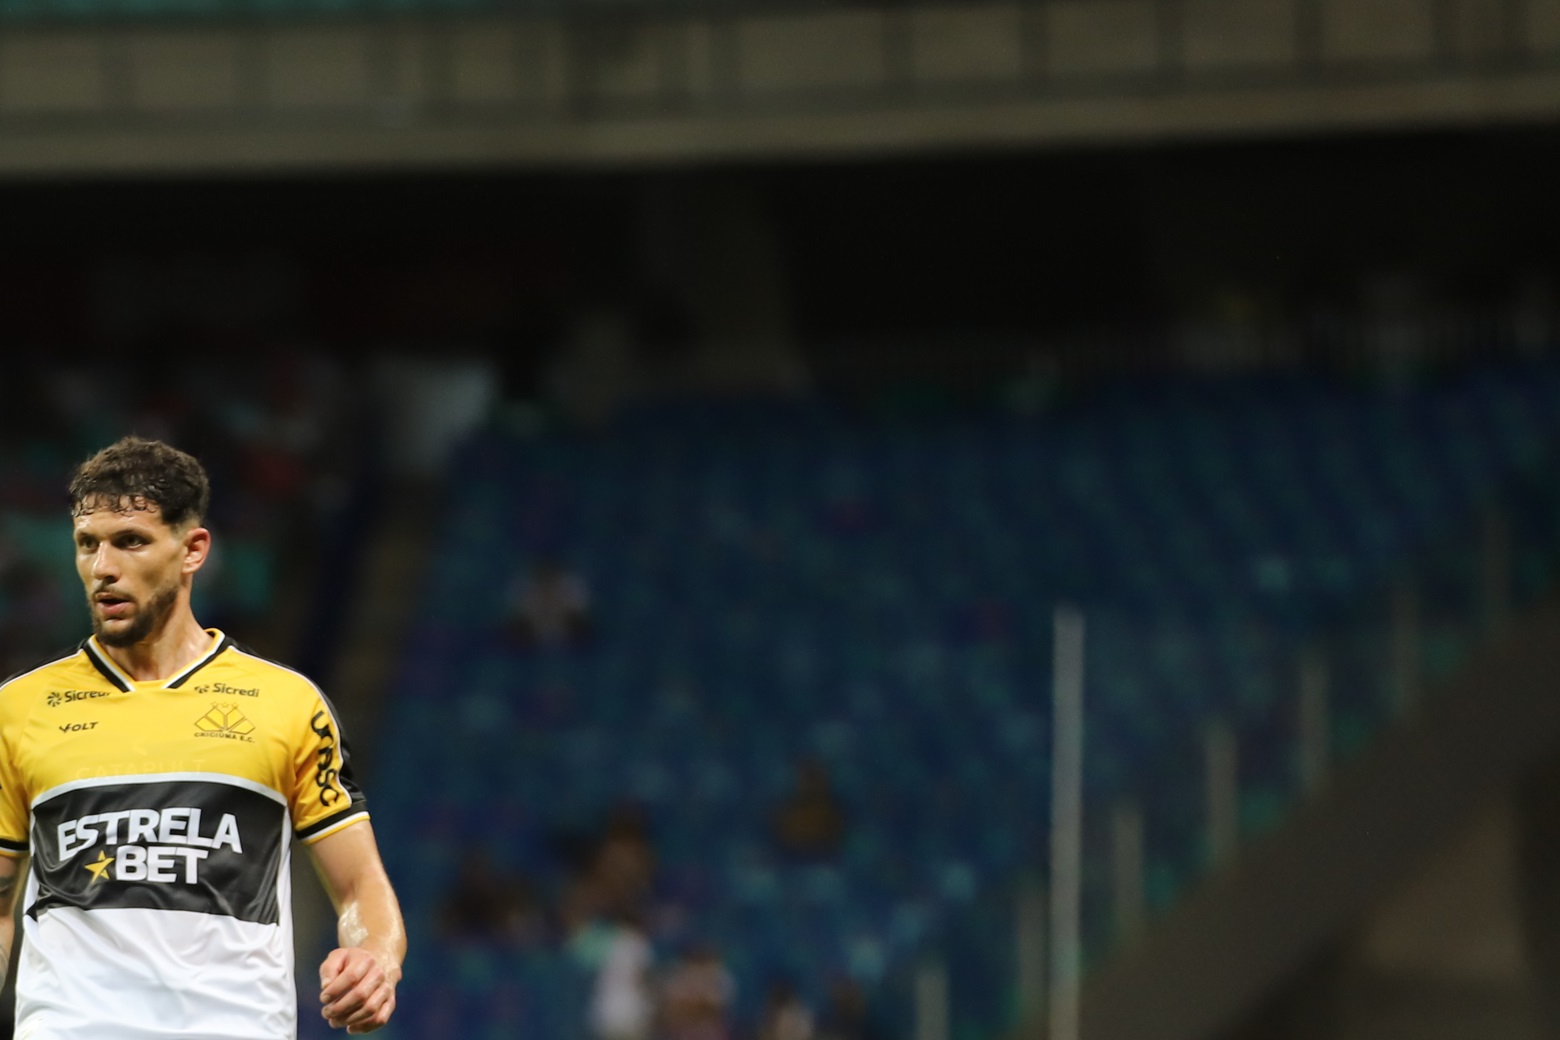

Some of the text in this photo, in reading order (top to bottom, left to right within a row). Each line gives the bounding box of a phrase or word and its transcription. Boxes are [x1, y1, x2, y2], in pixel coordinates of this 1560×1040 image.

[212, 682, 260, 697] Sicredi
[58, 720, 100, 734] VOLT
[57, 807, 243, 861] ESTRELA
[115, 845, 209, 885] BET
